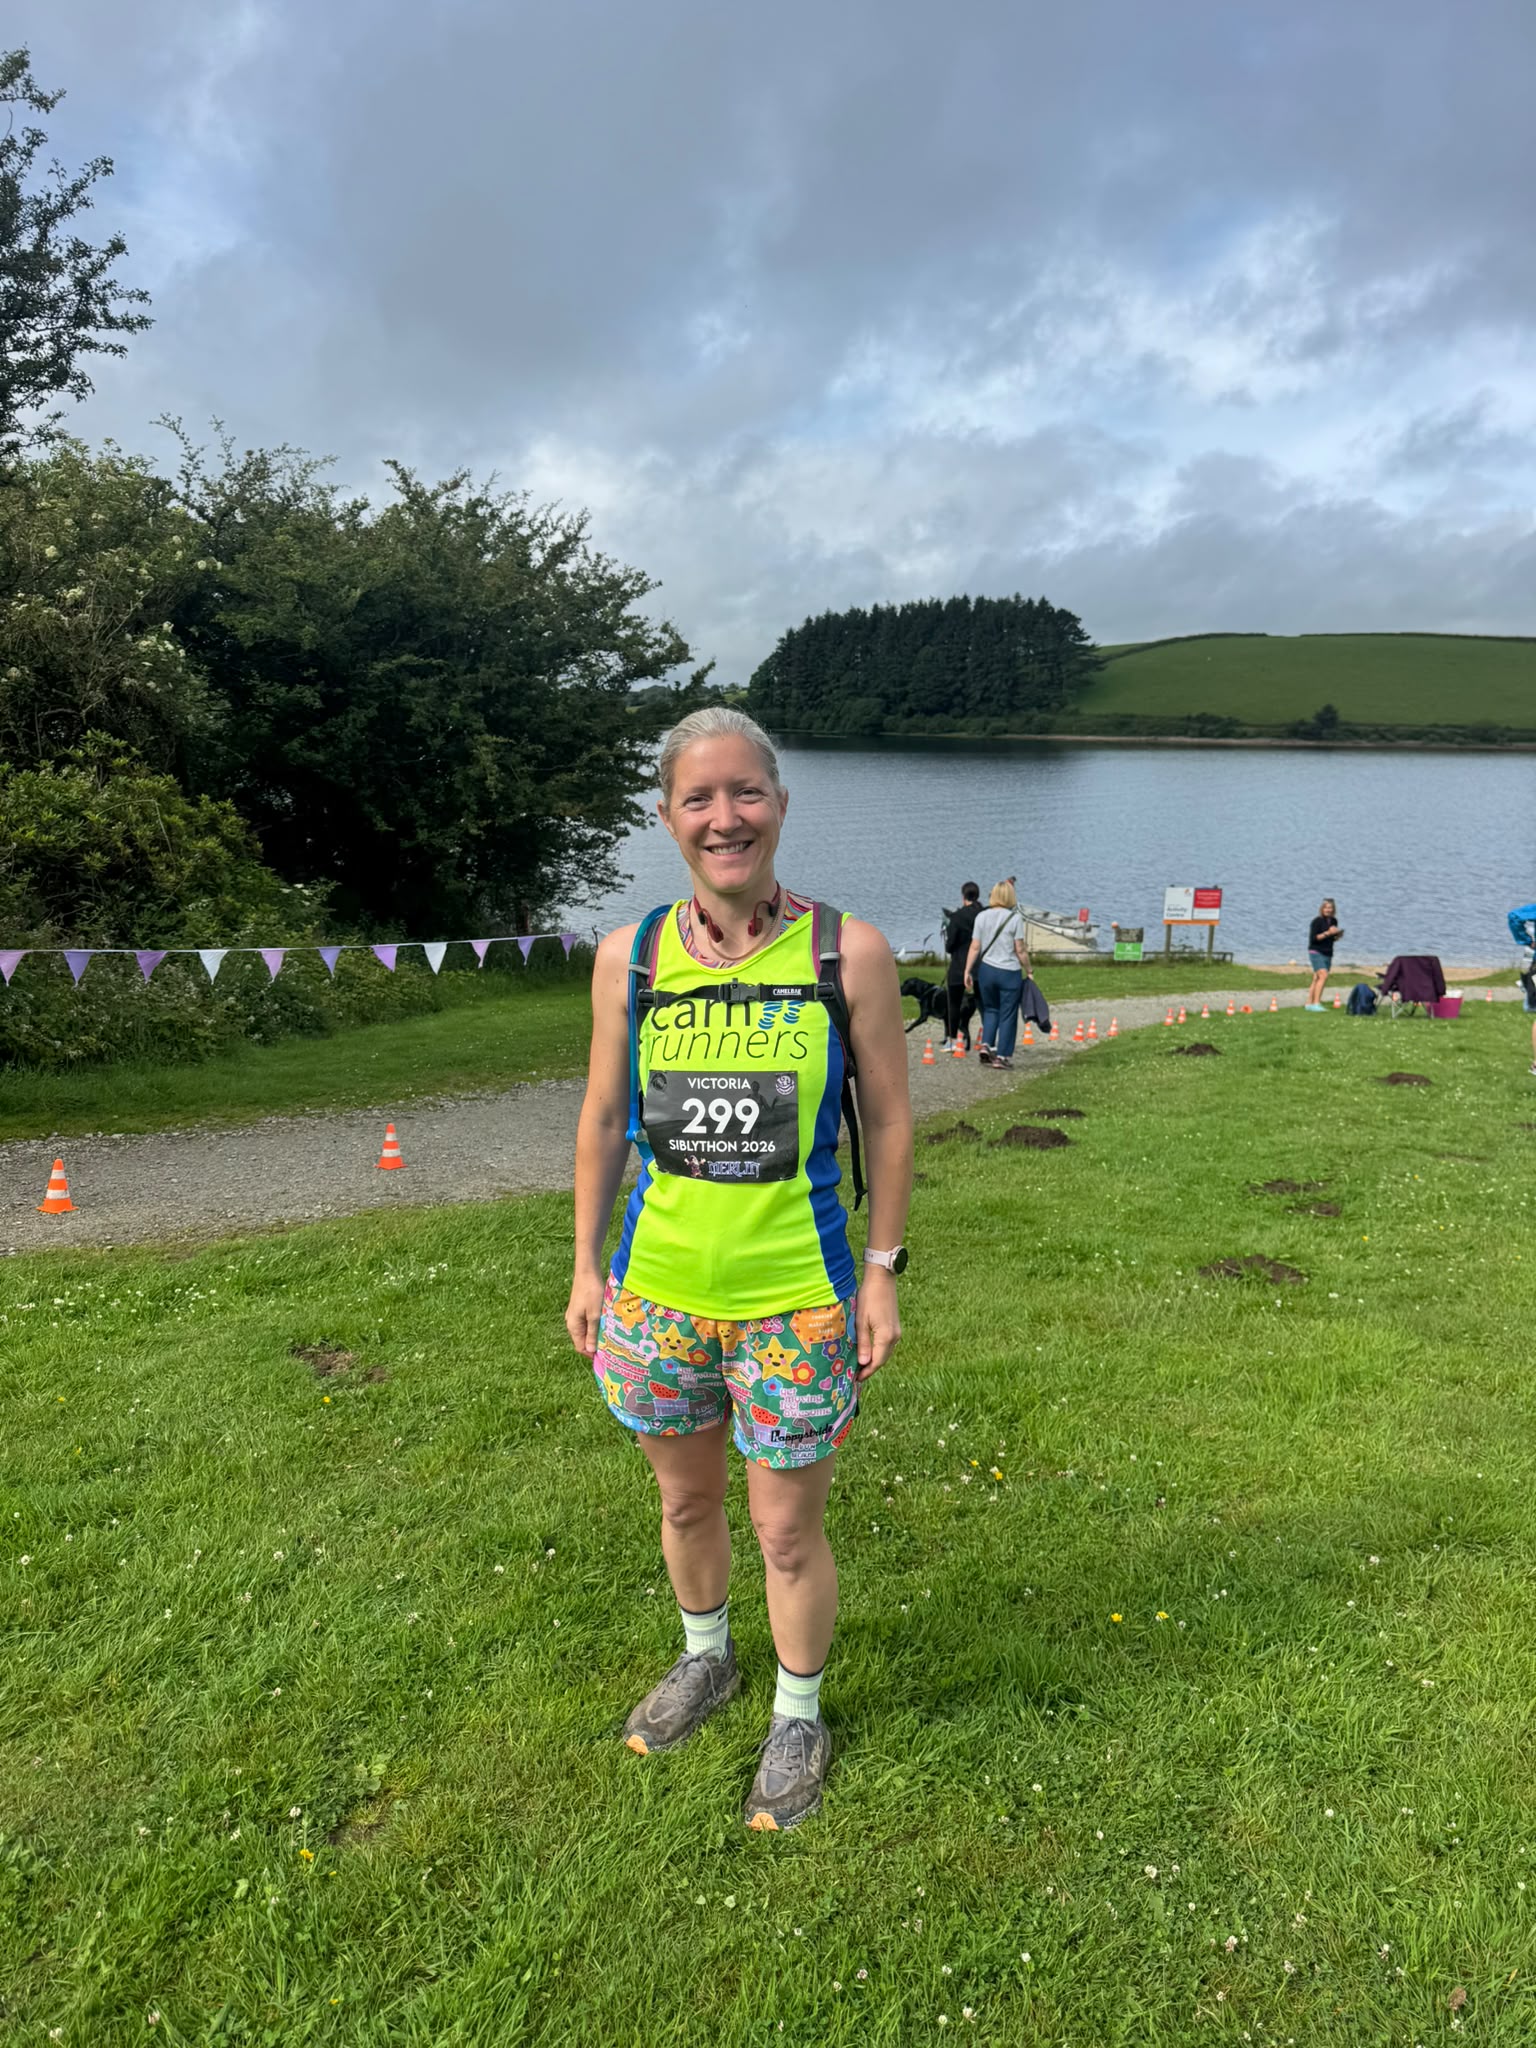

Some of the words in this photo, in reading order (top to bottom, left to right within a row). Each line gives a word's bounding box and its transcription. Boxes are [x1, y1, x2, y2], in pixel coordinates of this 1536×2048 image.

[772, 988, 802, 996] CAMELBAK
[650, 1000, 750, 1031] carn
[649, 1030, 808, 1063] runners
[687, 1077, 751, 1090] VICTORIA
[681, 1097, 760, 1135] 299
[668, 1139, 739, 1153] SIBLYTHON
[741, 1140, 776, 1153] 2026
[707, 1160, 761, 1178] MERLIN
[784, 1393, 824, 1404] moving
[783, 1407, 832, 1418] awesome
